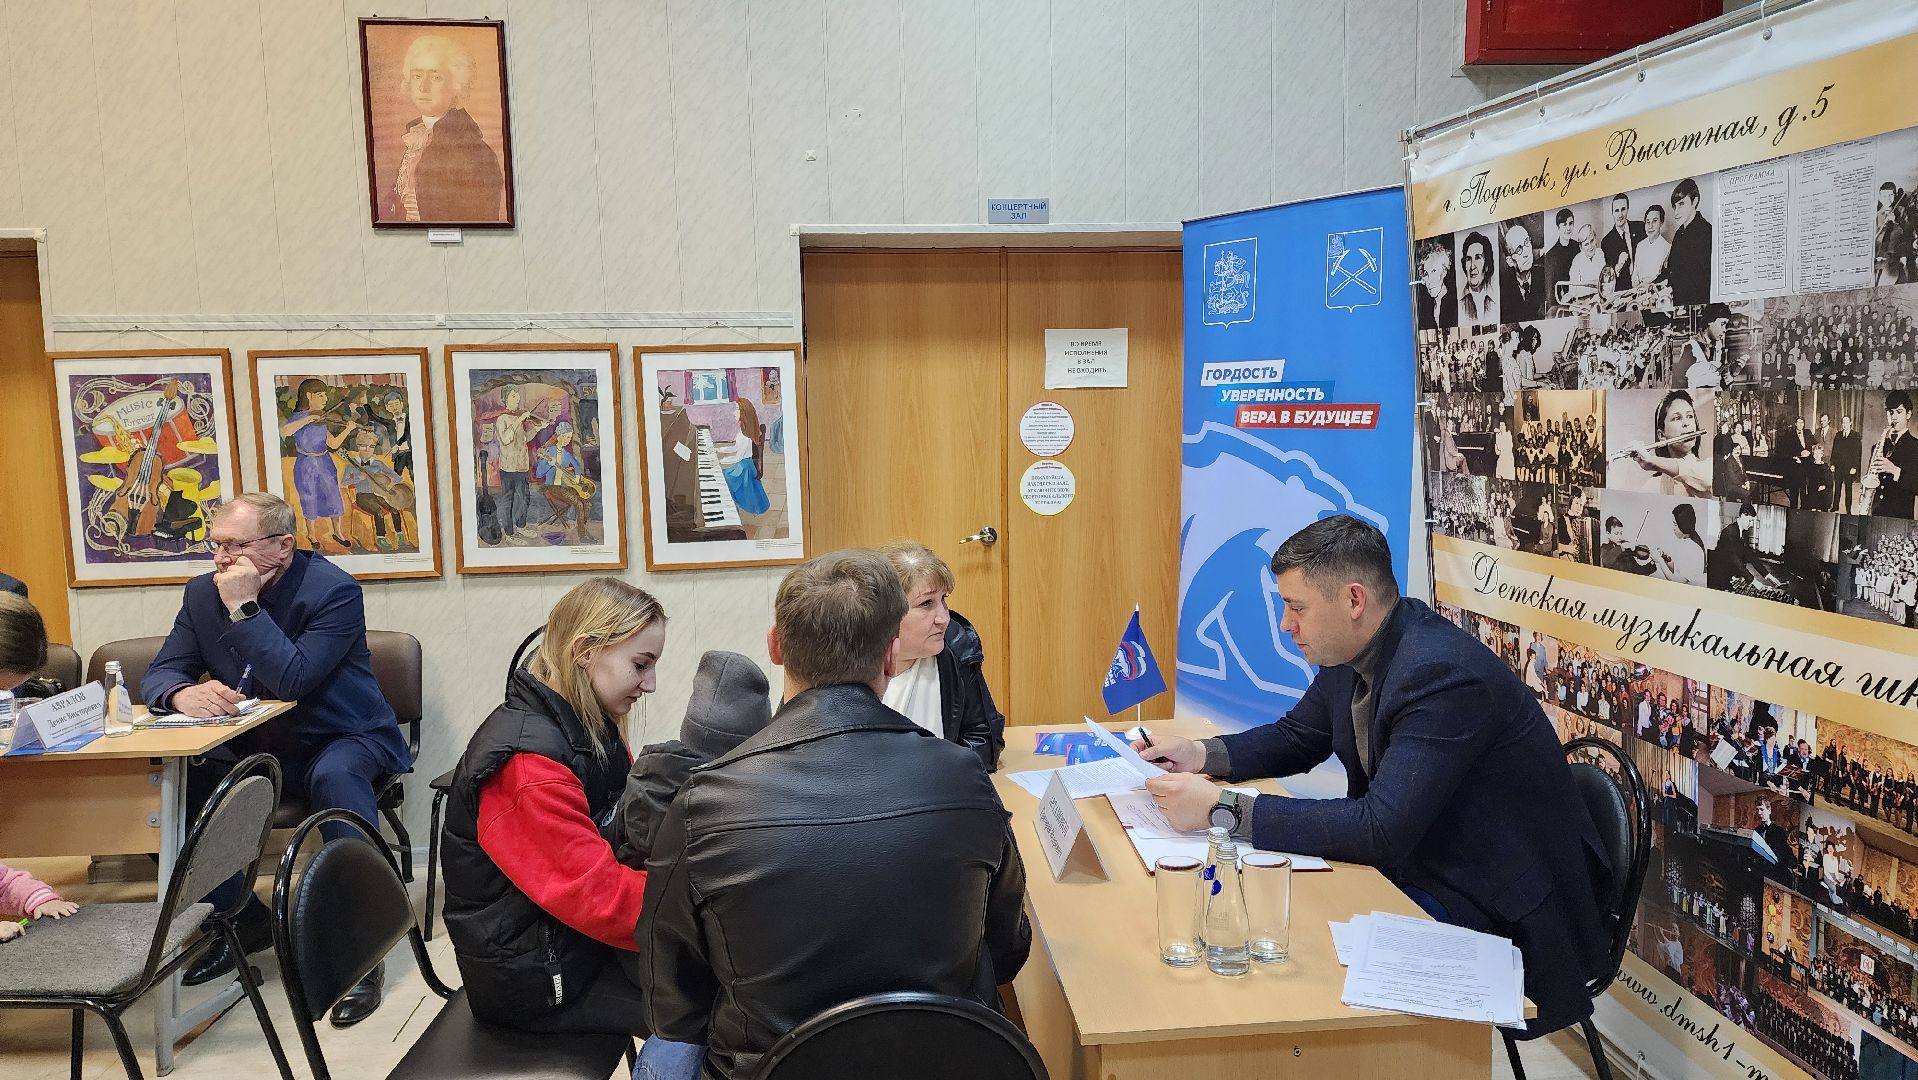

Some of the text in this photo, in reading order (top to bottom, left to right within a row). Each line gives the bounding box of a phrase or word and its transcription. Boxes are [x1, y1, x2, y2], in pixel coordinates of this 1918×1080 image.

[1443, 199, 1456, 213] г.
[1459, 157, 1556, 214] Подольск,
[1560, 161, 1597, 197] ул.
[1605, 114, 1768, 171] Высотная,
[991, 201, 1047, 212] КОНЦЕРТНЫЙ
[1011, 212, 1027, 220] ЗАЛ
[1205, 366, 1278, 382] ГОРДОСТЬ
[1221, 387, 1325, 402] УВЕРЕННОСТЬ
[1240, 410, 1374, 427] ВЕРА В БУДУЩЕЕ
[1471, 551, 1588, 620] Детская
[1593, 608, 1845, 688] музыкальная
[48, 714, 68, 730] Денис
